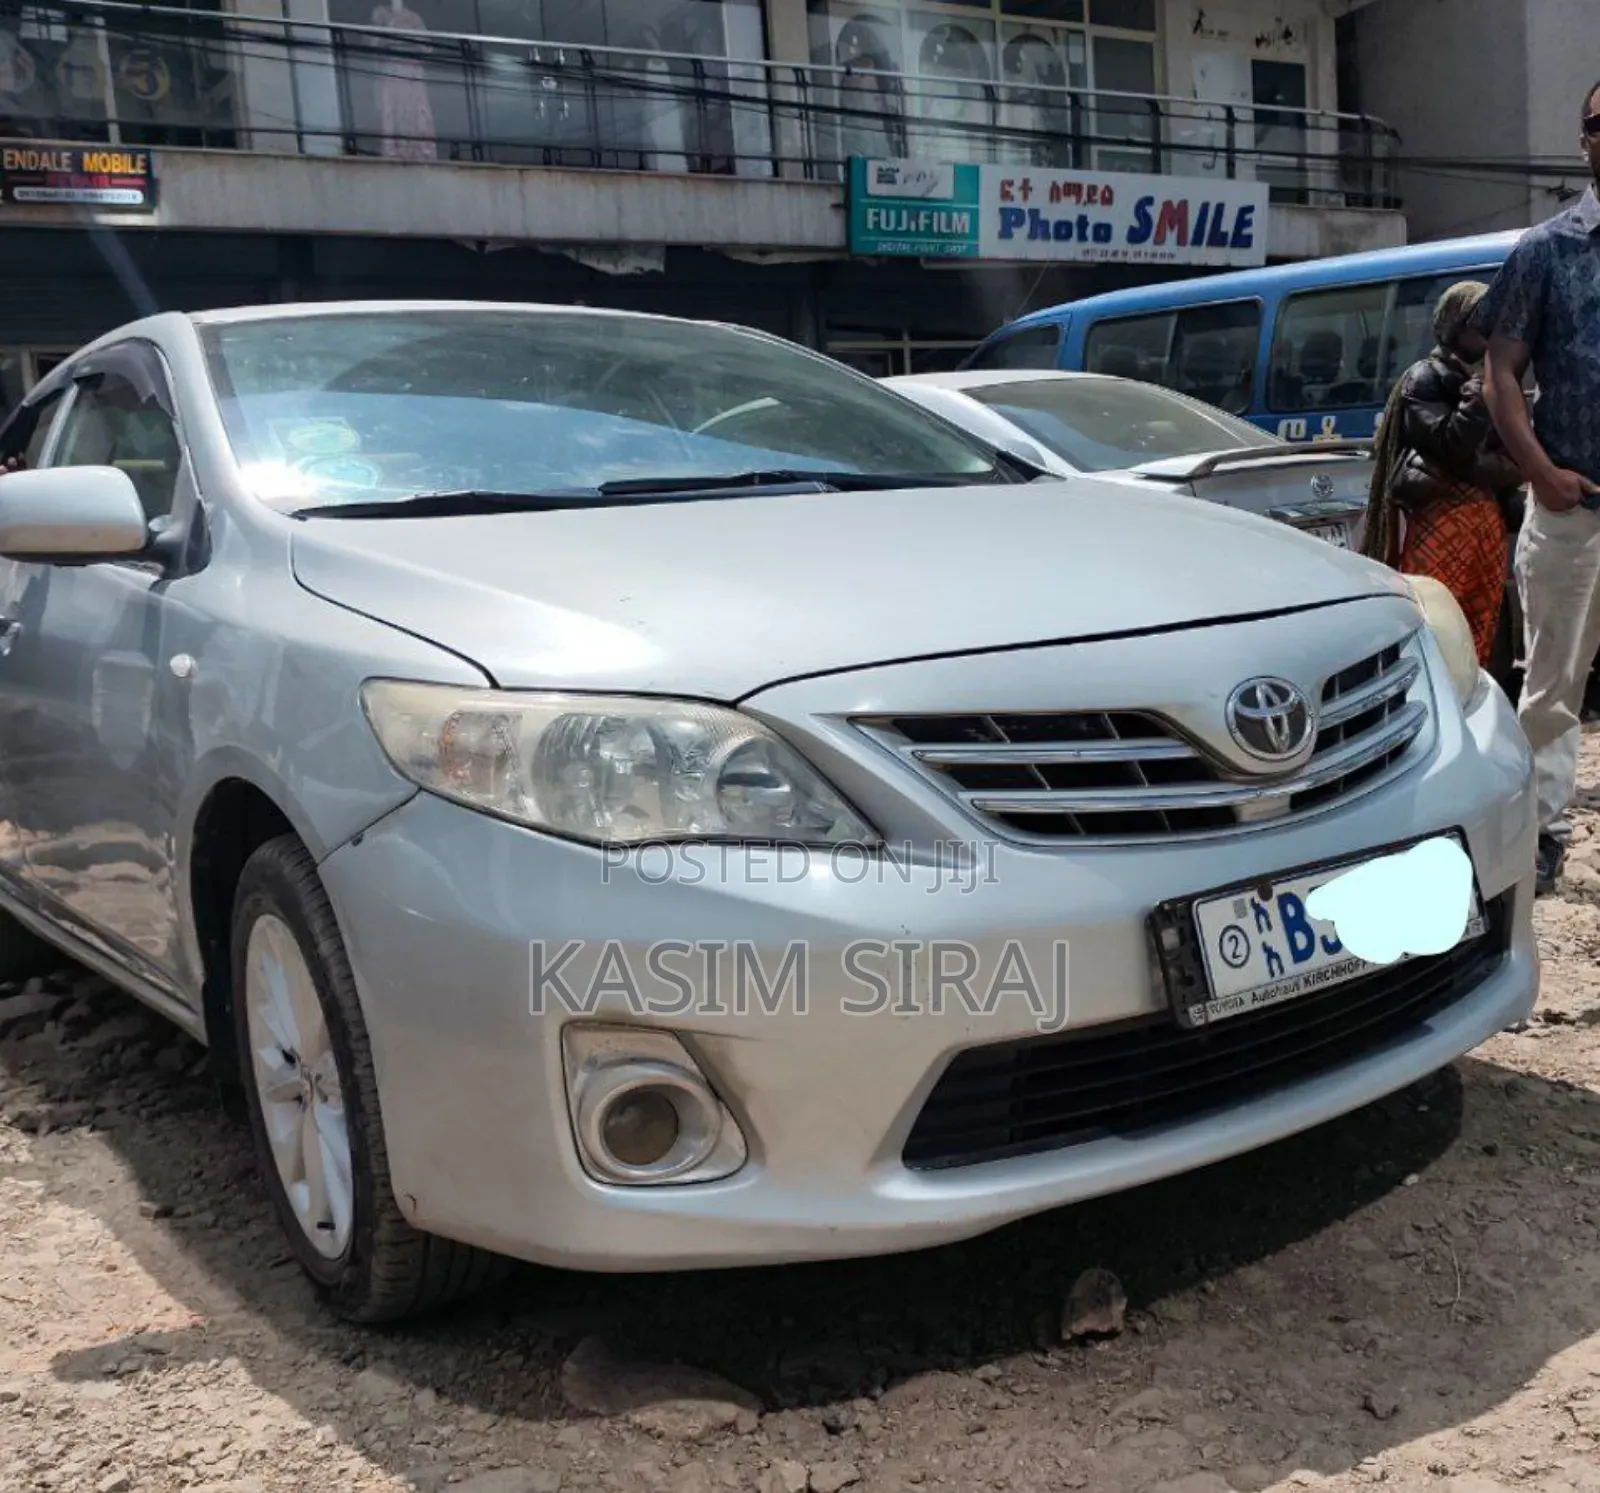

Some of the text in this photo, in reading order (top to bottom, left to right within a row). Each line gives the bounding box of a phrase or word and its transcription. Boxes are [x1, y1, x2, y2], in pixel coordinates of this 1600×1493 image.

[3, 151, 148, 174] ENDALE MOBILE
[998, 195, 1255, 248] Photo SMILE
[1252, 981, 1301, 1005] Autohaus
